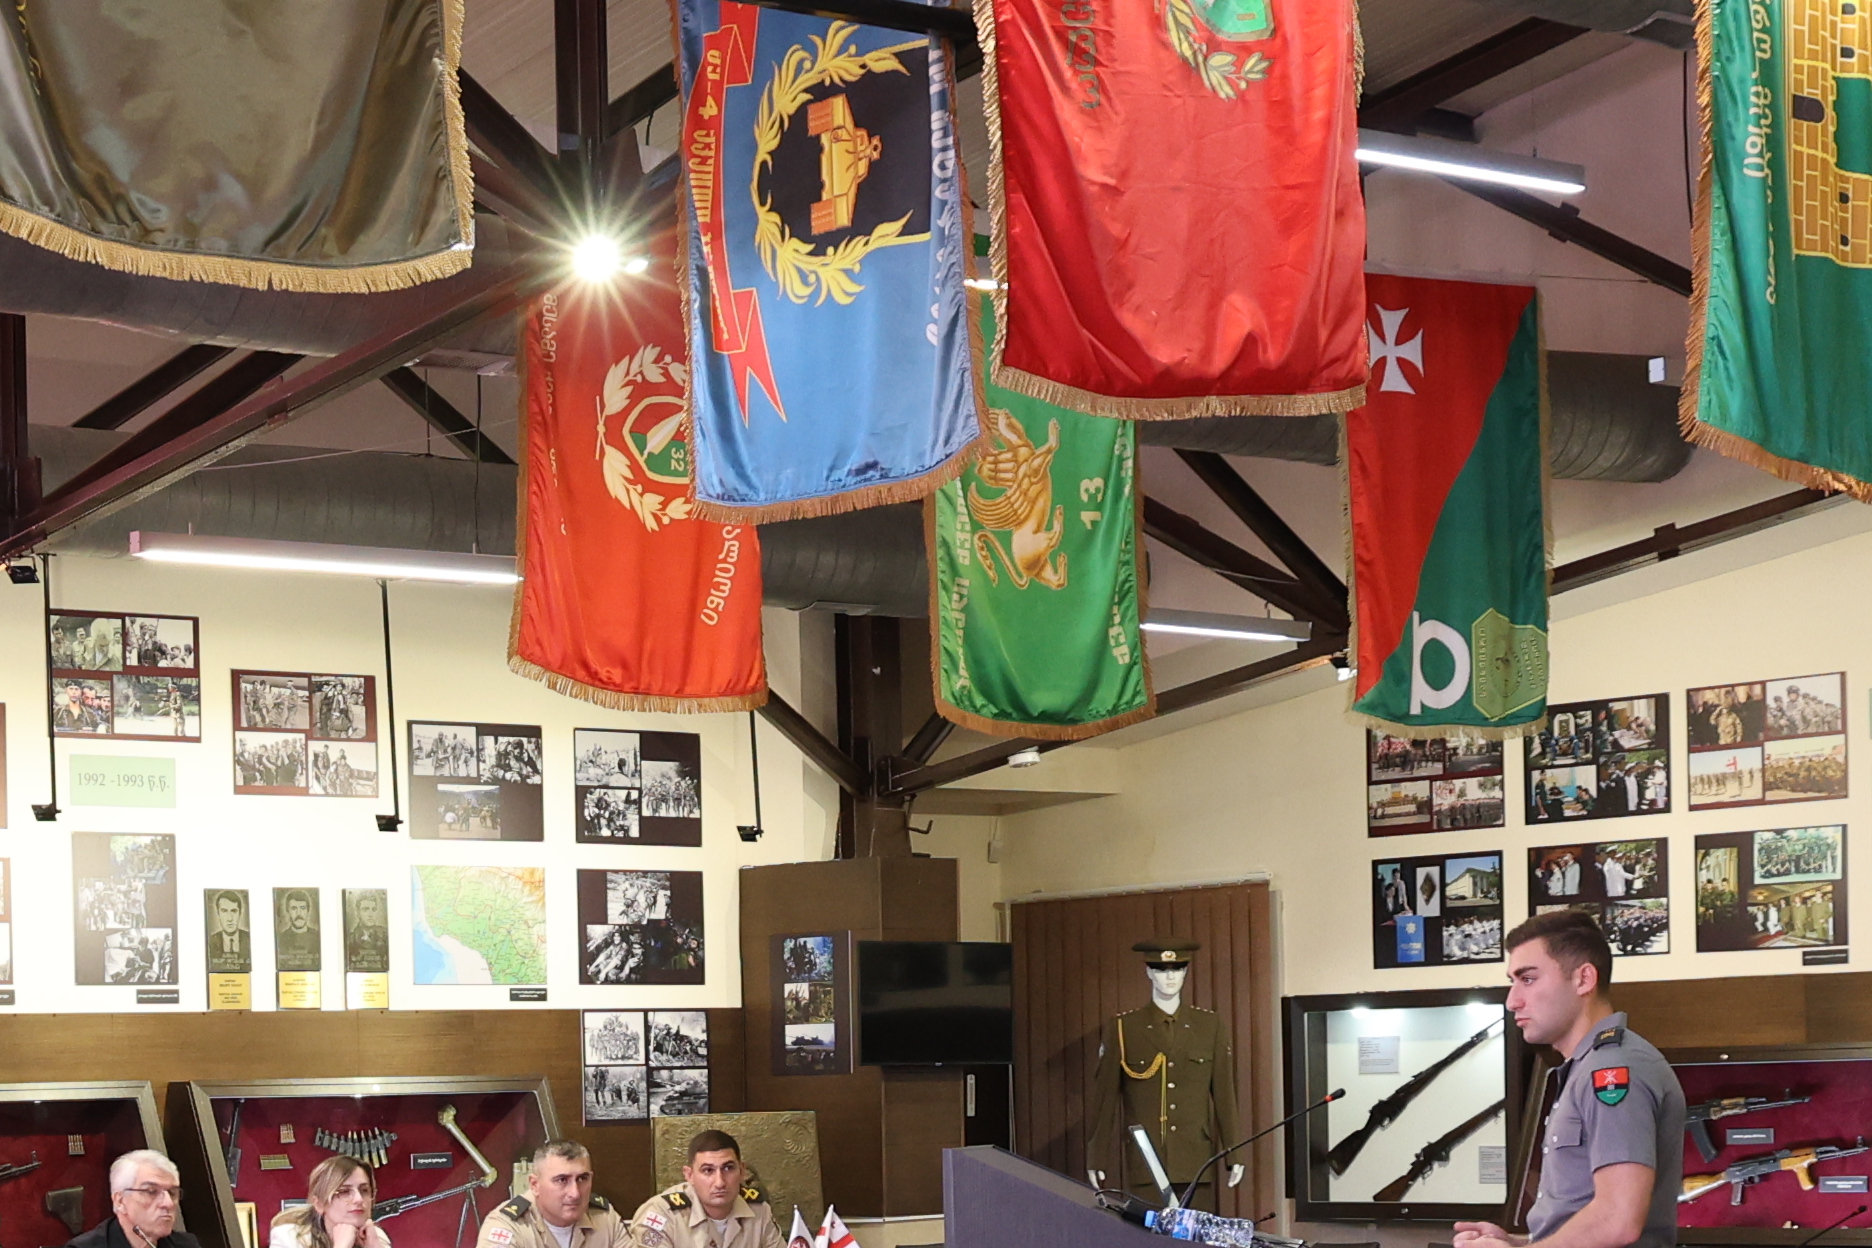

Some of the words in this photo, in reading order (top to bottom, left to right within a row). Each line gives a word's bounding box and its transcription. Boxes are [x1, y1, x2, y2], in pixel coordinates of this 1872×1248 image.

[670, 447, 685, 471] 32
[1078, 477, 1105, 530] 13
[700, 525, 742, 626] ალიონი
[76, 771, 107, 788] 1992
